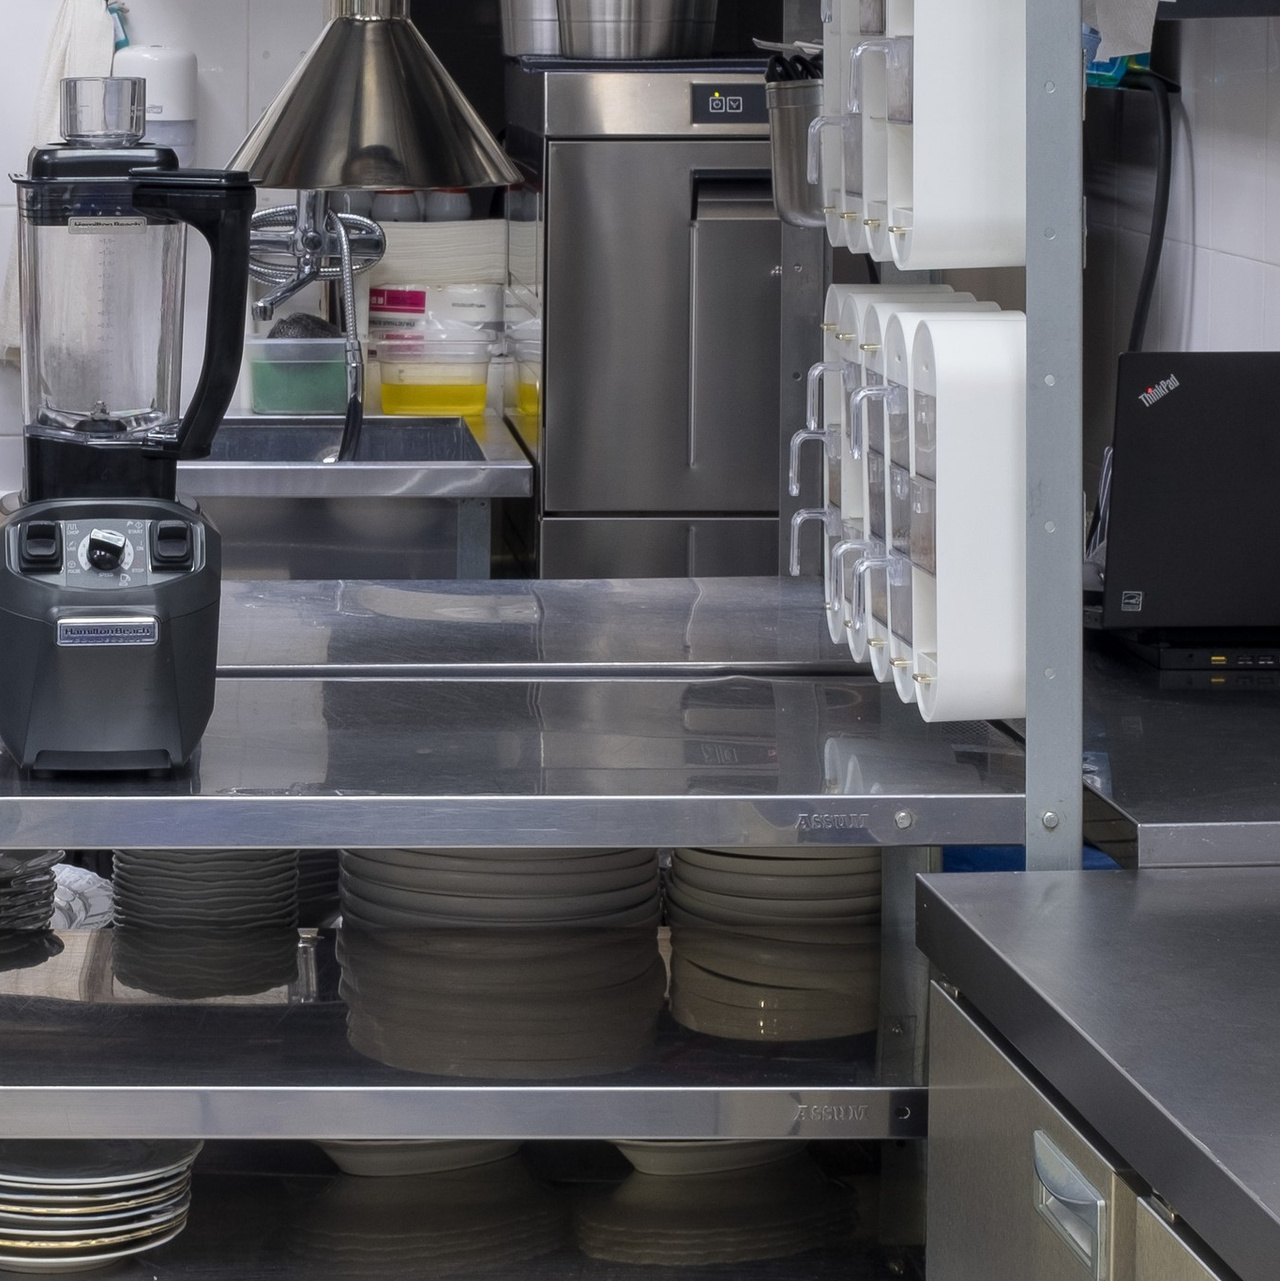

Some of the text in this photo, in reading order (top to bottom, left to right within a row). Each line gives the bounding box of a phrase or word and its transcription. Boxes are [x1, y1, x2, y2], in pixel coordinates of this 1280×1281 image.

[1138, 373, 1180, 407] ThinkPad
[65, 627, 150, 636] Hamilton Beach
[795, 813, 870, 829] ASSUM
[793, 1104, 869, 1120] ASSUM
